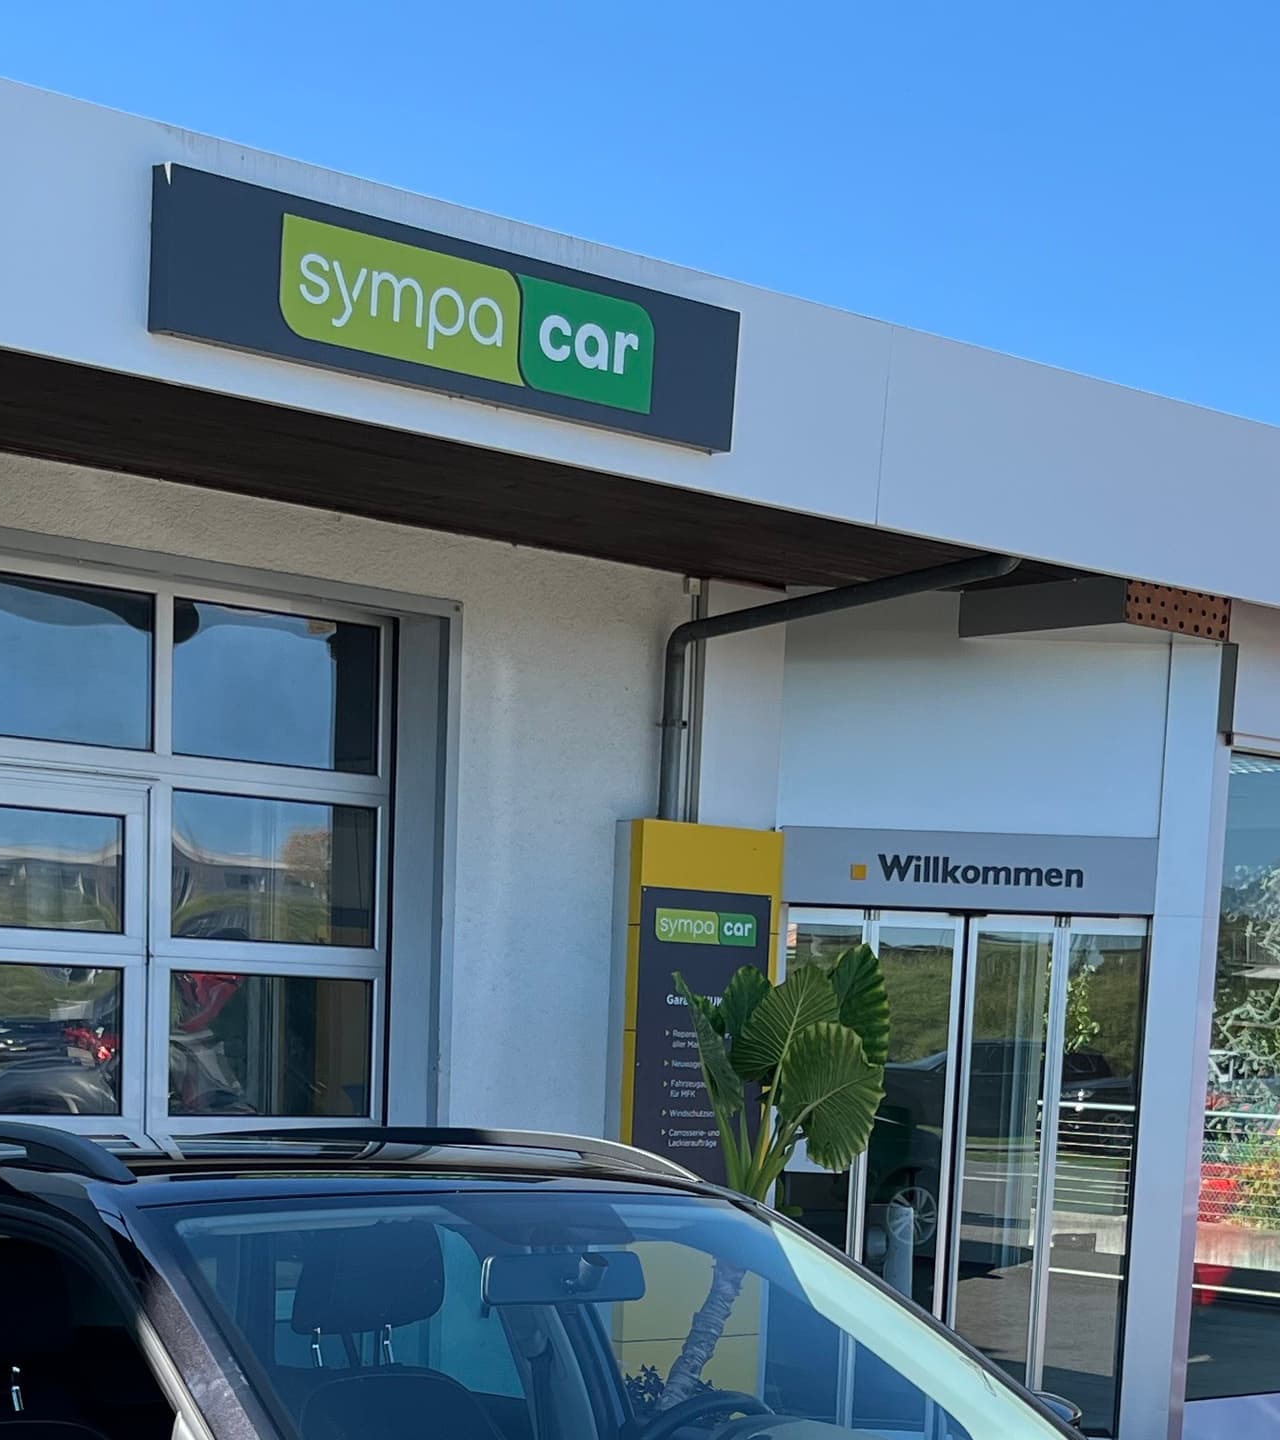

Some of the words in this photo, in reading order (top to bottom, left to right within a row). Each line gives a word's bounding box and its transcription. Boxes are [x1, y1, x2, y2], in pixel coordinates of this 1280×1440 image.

[298, 252, 504, 350] sympa
[538, 313, 640, 375] car
[877, 853, 1084, 889] Willkommen
[660, 917, 715, 940] sympa
[723, 922, 753, 937] car
